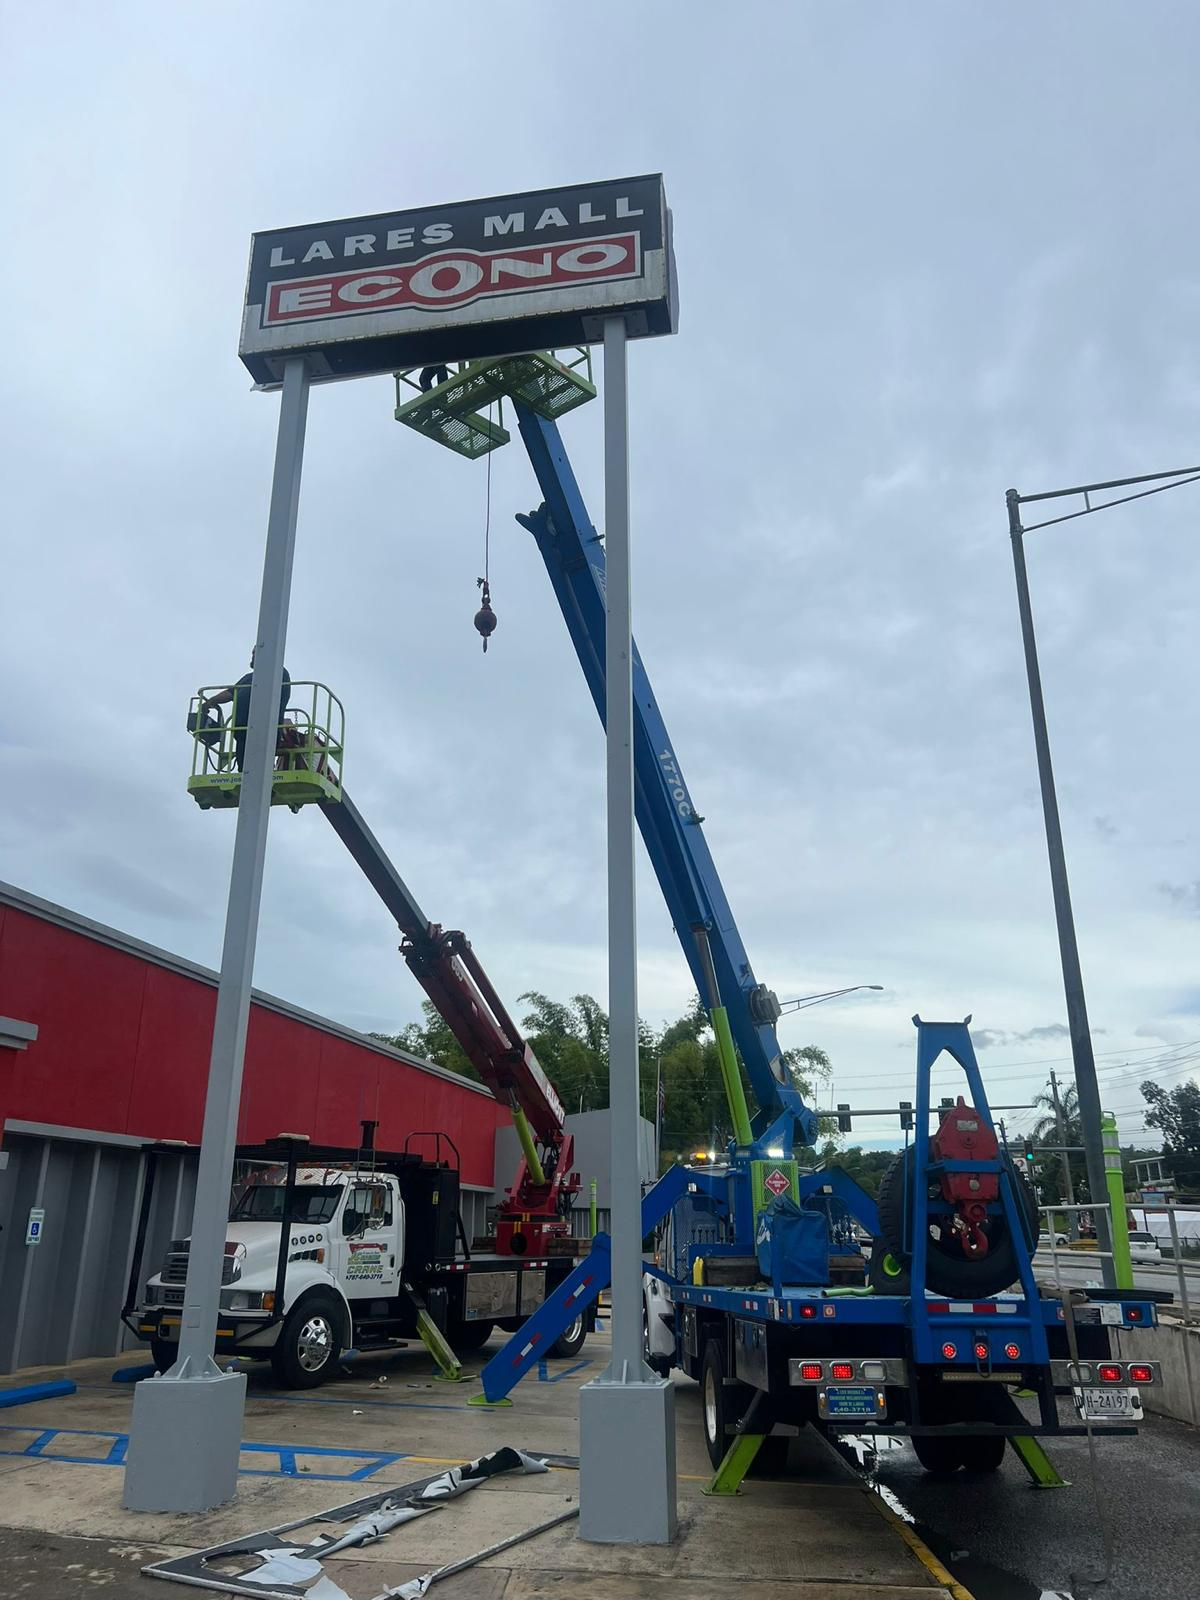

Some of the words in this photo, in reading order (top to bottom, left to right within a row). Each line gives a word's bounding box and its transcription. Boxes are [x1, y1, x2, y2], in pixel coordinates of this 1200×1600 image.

[270, 223, 454, 268] LARES
[484, 196, 644, 238] MALL
[278, 243, 628, 315] ECONO
[659, 749, 691, 817] 1770C
